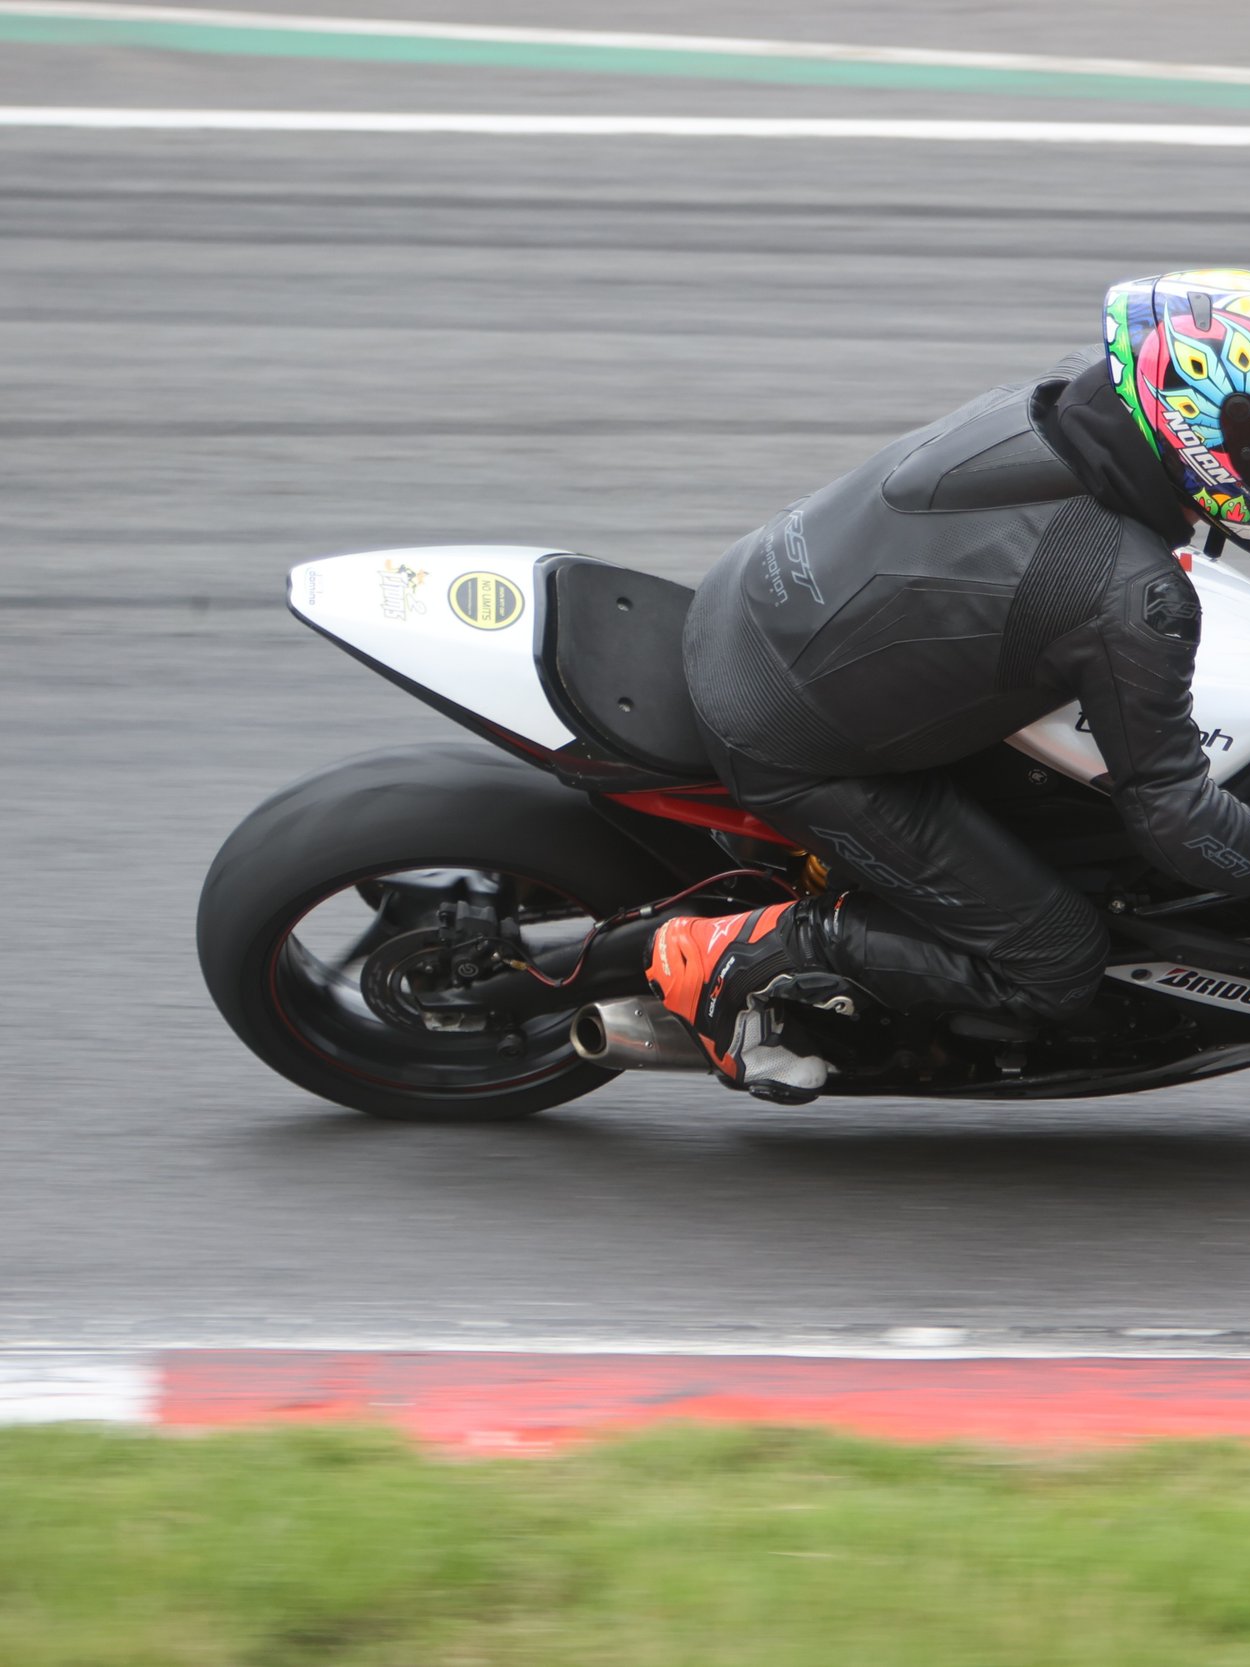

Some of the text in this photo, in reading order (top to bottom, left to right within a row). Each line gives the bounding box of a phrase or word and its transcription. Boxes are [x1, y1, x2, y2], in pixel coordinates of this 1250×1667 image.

[1162, 410, 1238, 485] NOLAN
[785, 510, 825, 605] RST
[482, 580, 491, 621] NO LIMITS
[1147, 598, 1202, 619] RS
